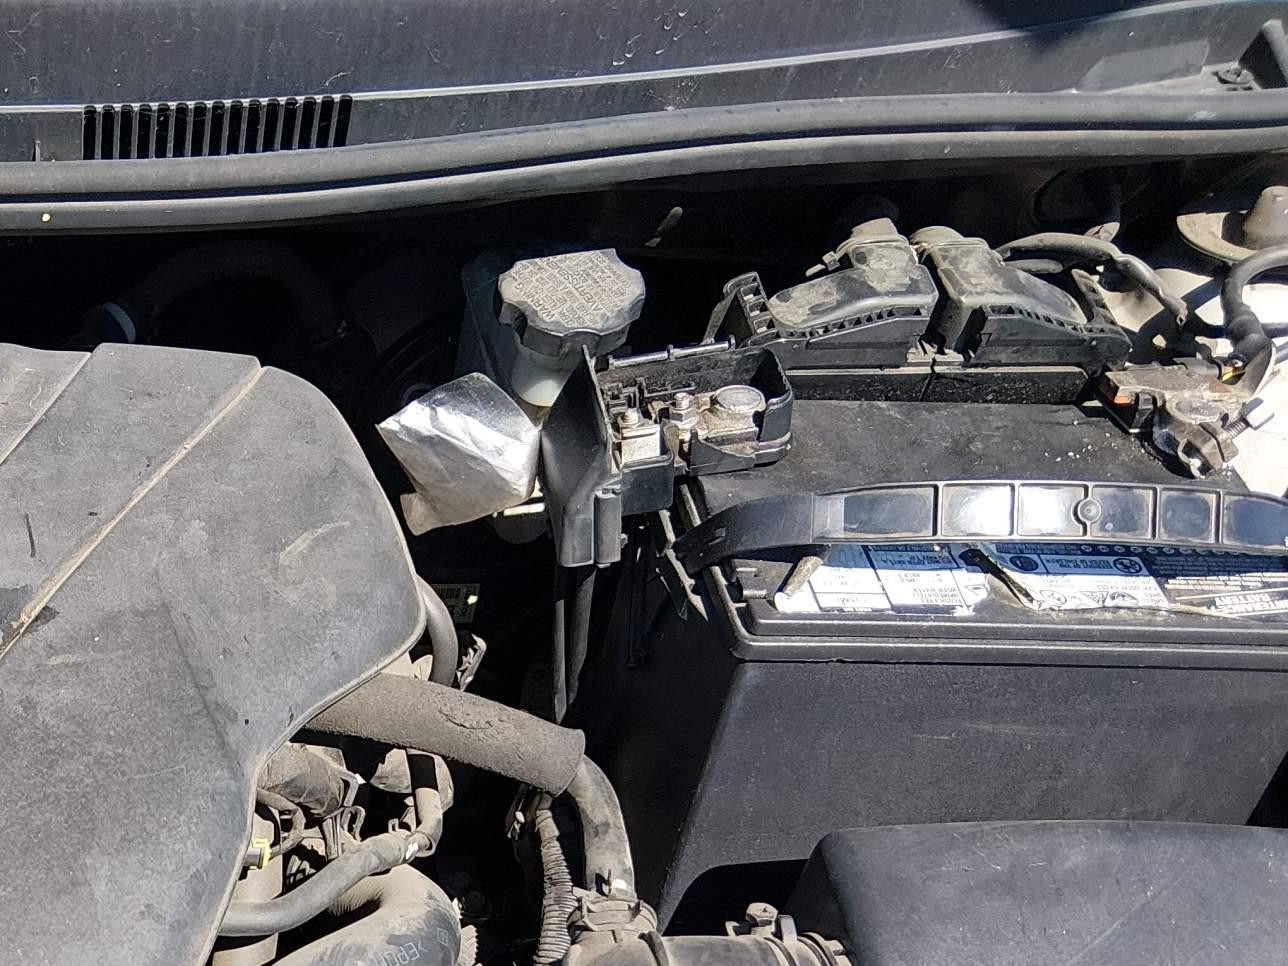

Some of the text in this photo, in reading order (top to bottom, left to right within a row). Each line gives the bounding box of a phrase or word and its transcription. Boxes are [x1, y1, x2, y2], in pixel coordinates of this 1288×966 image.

[515, 282, 555, 320] WARNING
[541, 257, 603, 312] AVERTISSEMEN
[1215, 593, 1270, 606] BATTERY
